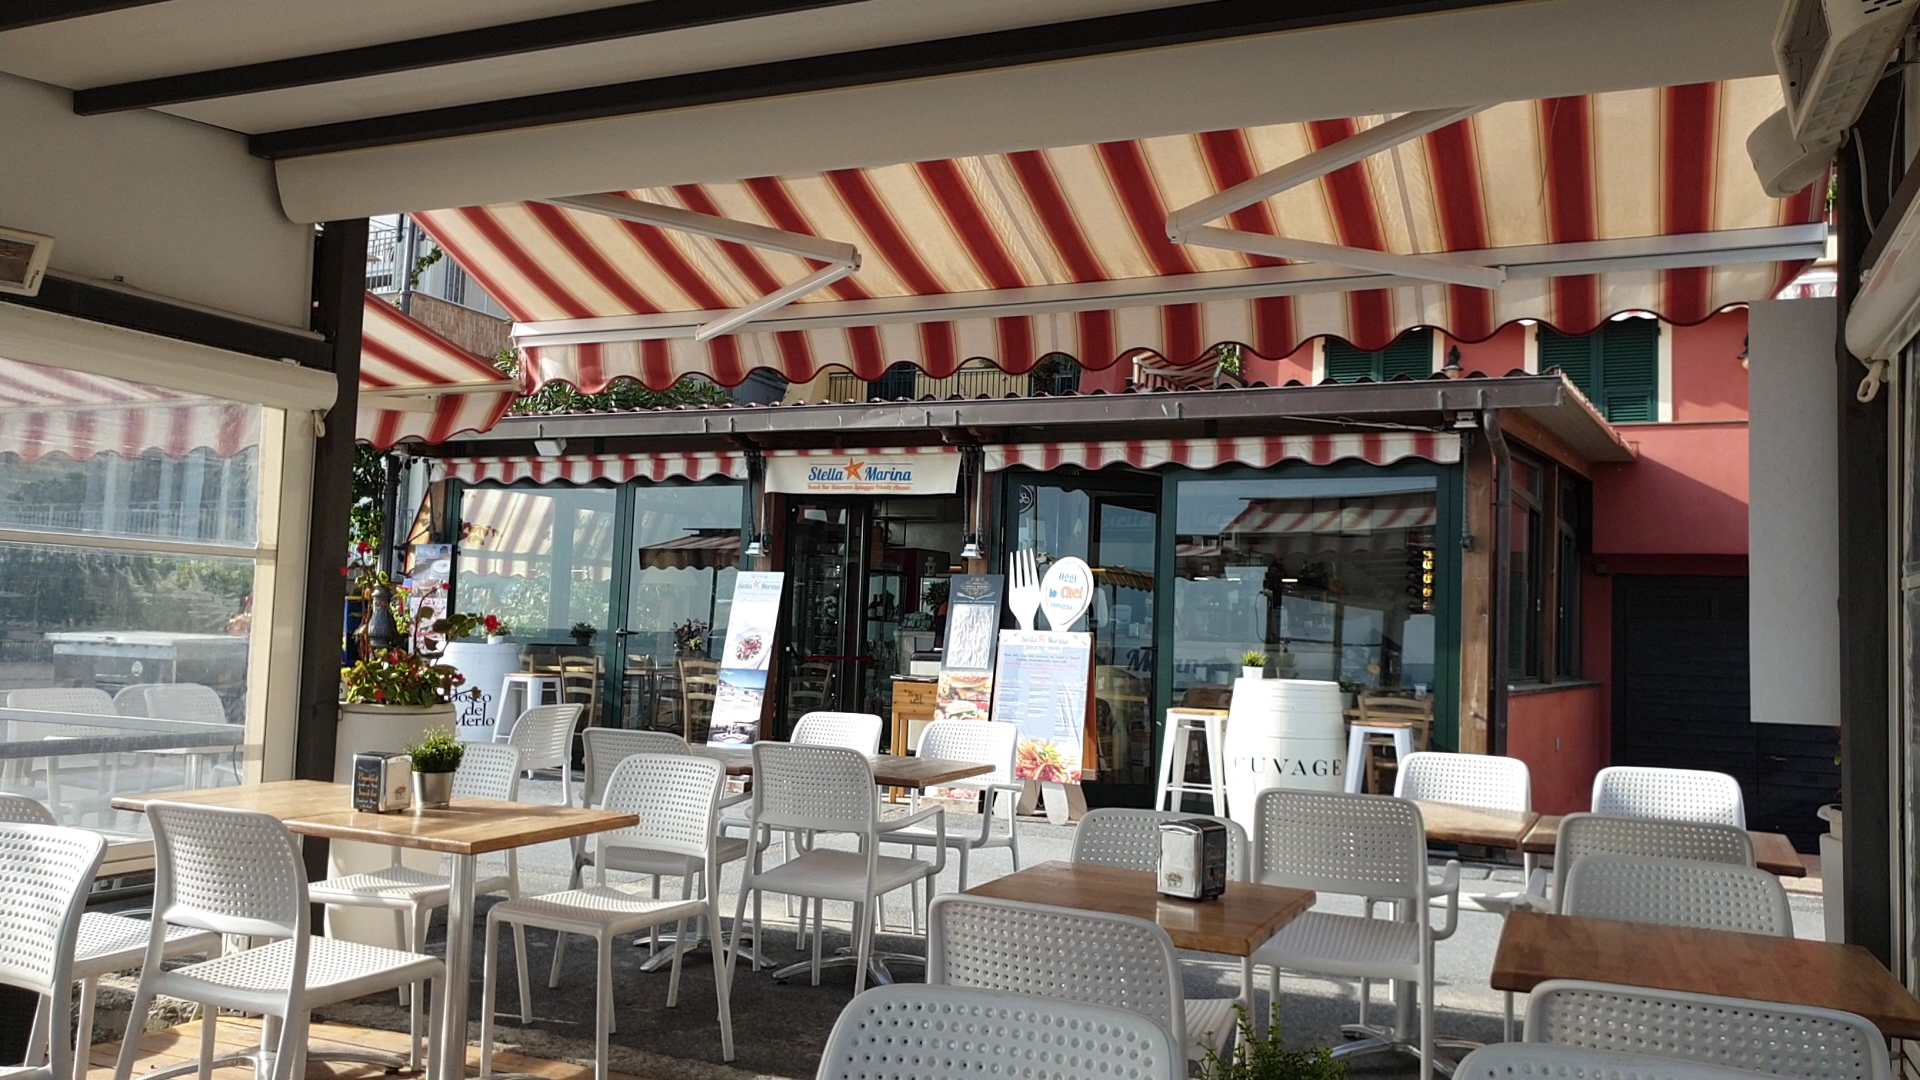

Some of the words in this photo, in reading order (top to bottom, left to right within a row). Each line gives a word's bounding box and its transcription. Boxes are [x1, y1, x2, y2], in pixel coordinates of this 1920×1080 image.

[808, 466, 844, 481] Stella
[865, 466, 912, 481] Marina
[1060, 586, 1084, 599] Chef
[1048, 636, 1069, 644] Marina
[465, 701, 486, 716] del
